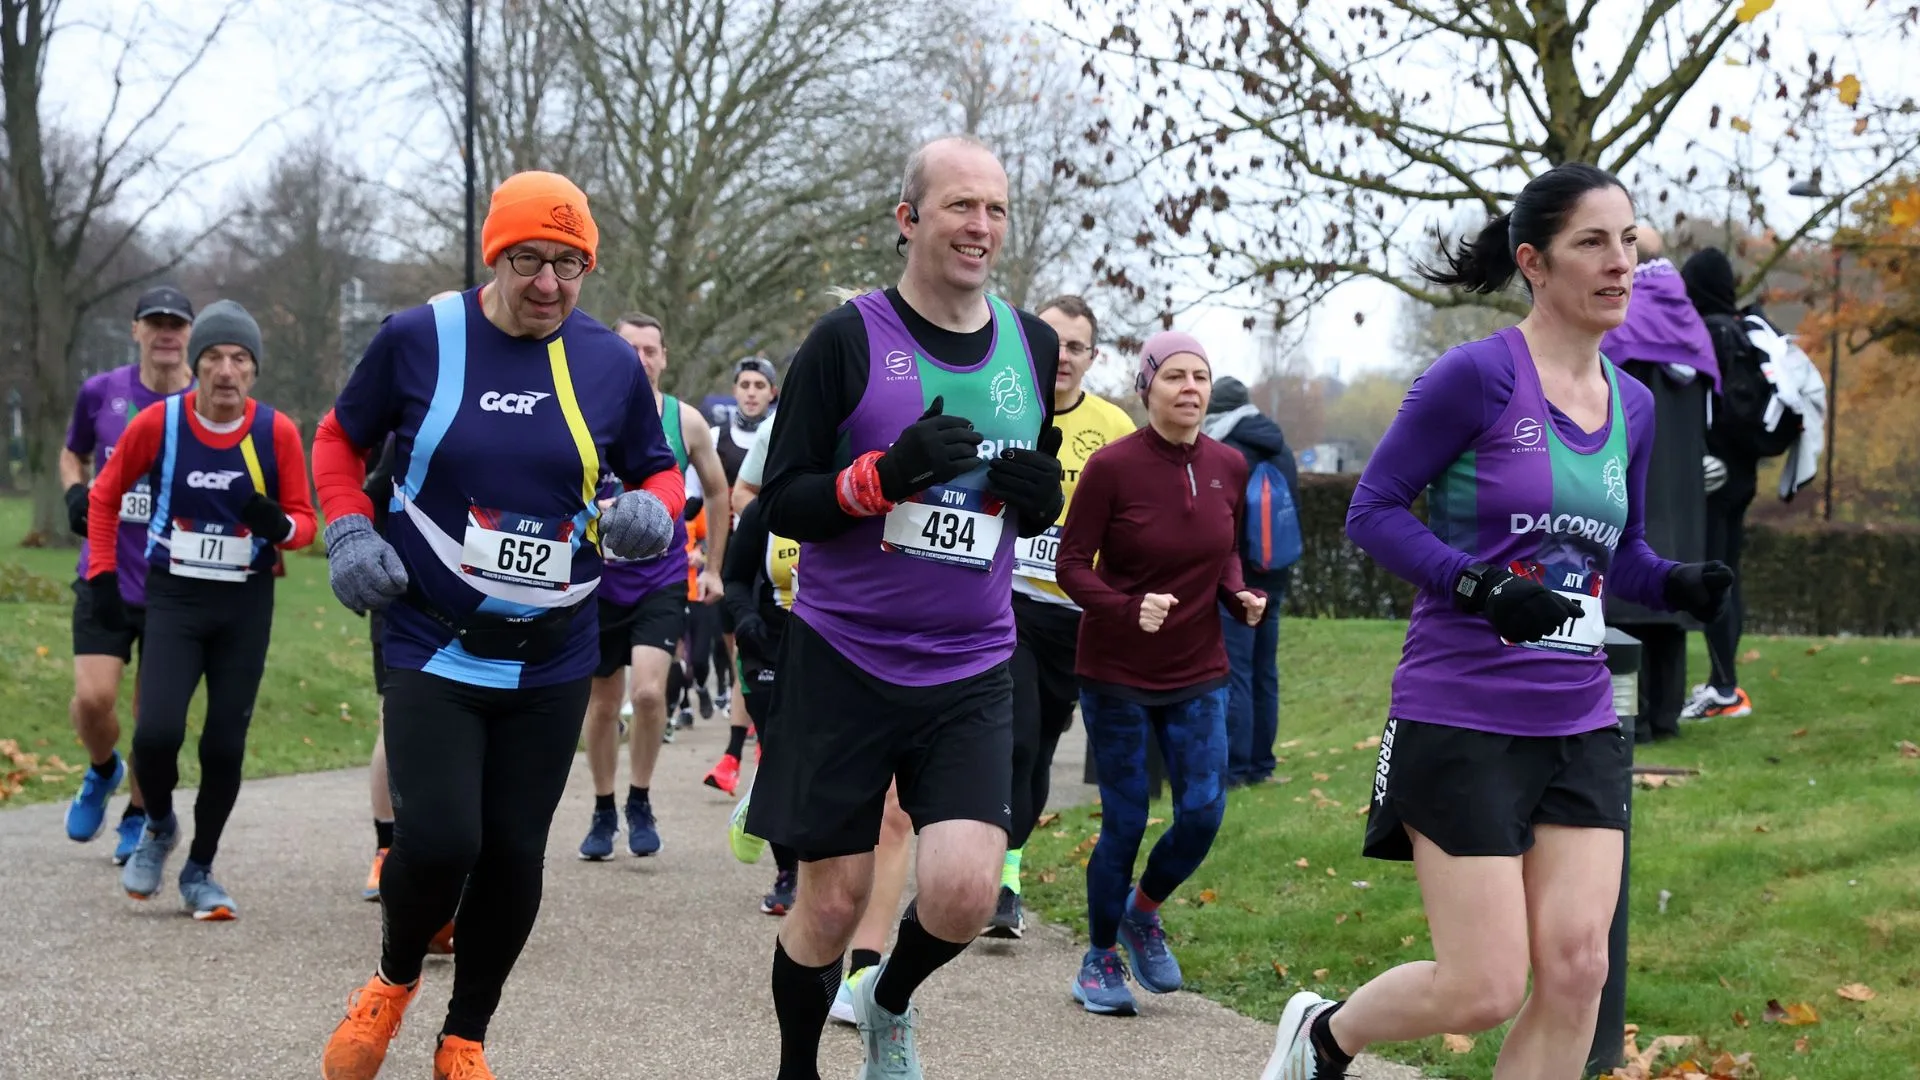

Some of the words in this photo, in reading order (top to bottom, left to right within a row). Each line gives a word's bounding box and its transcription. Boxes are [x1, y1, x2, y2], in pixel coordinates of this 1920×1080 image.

[480, 391, 546, 415] GCR
[187, 471, 240, 490] GCR
[941, 490, 966, 505] ATW
[516, 519, 543, 534] ATW
[921, 511, 976, 552] 434
[1510, 513, 1622, 550] DACORUM
[200, 538, 224, 560] 171
[497, 538, 551, 576] 652
[1029, 538, 1059, 562] 190
[1562, 572, 1584, 589] ATW
[1374, 719, 1397, 807] TERREX
